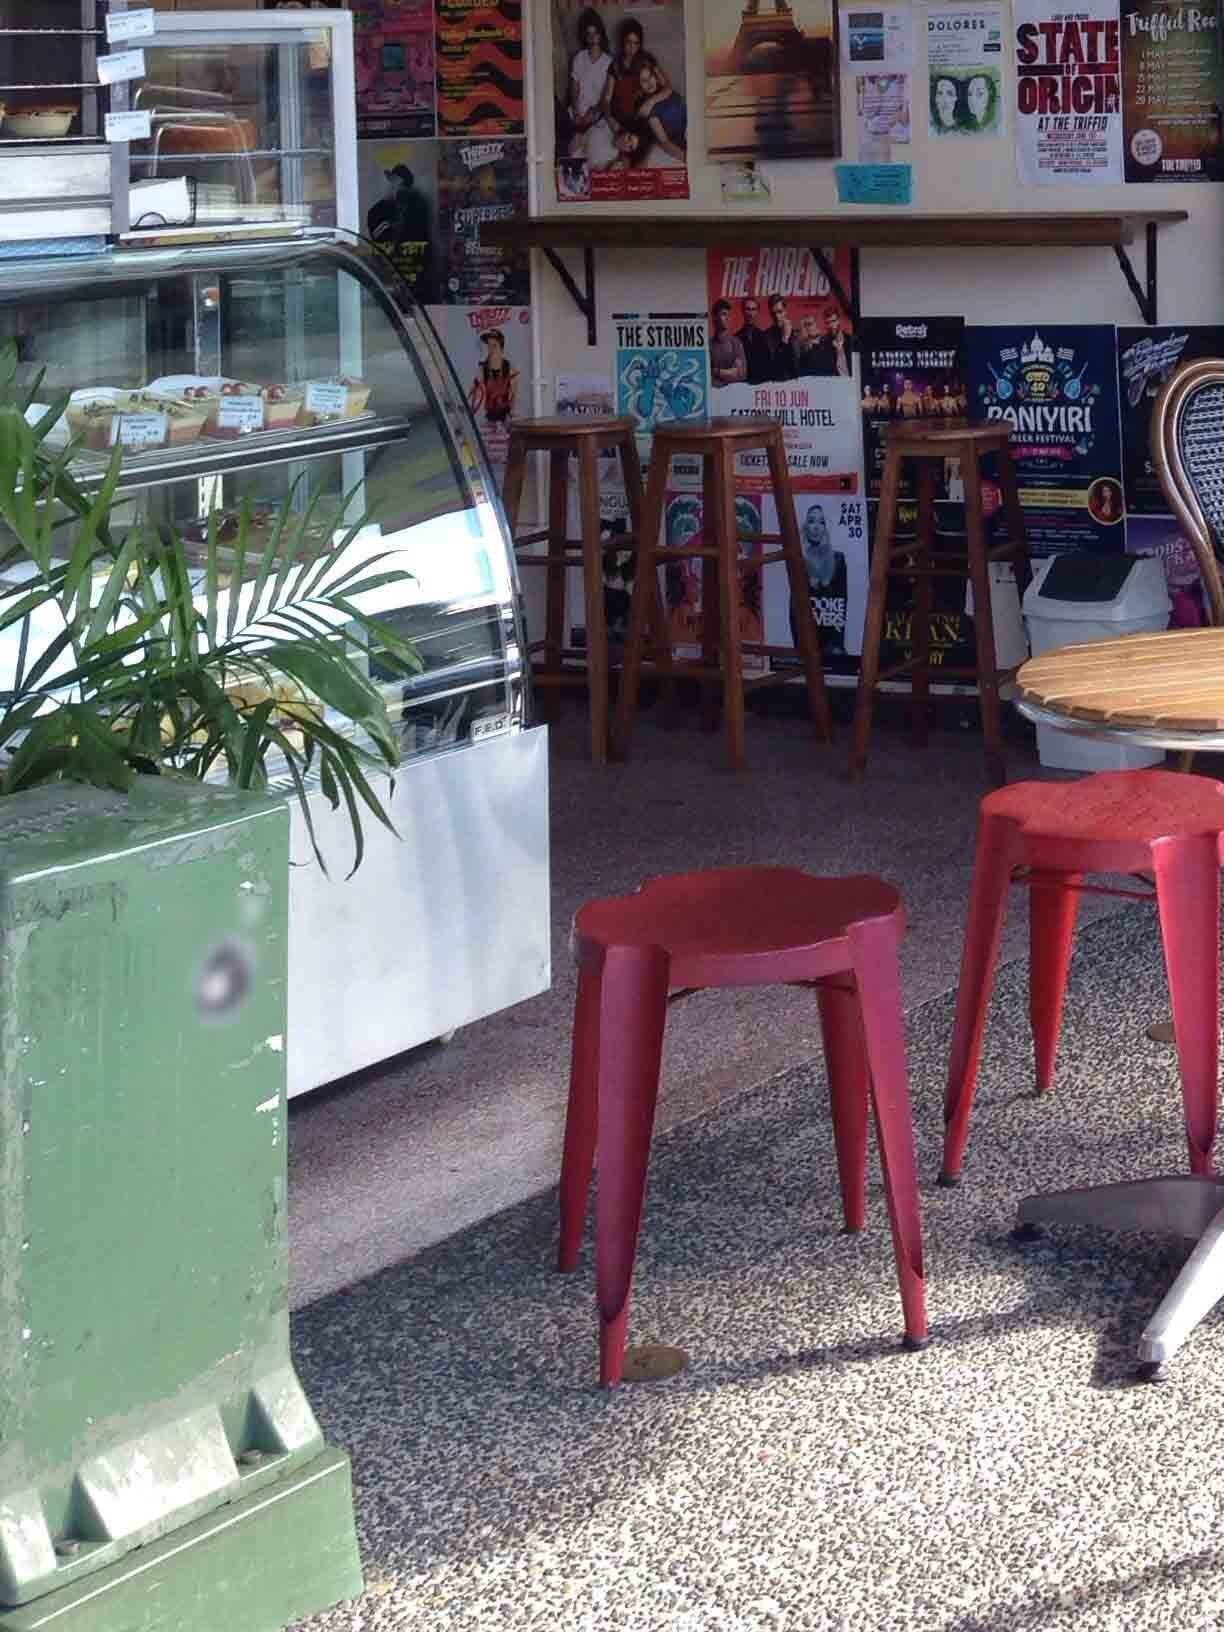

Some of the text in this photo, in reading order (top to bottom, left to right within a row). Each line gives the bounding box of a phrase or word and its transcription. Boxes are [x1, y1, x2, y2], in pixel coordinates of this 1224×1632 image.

[927, 20, 986, 31] DOLORES
[1016, 20, 1119, 65] STATE
[1037, 116, 1049, 130] AT
[1053, 116, 1069, 129] THE
[720, 257, 752, 297] THE
[617, 325, 705, 347] THE STRUMS
[871, 350, 957, 369] LADIES NIGHT
[754, 390, 774, 407] FRI
[789, 389, 809, 406] JUN
[800, 408, 836, 426] HOTEL
[1035, 434, 1076, 443] FESTIVAL
[740, 454, 770, 468] TICKET
[809, 455, 829, 468] NOW
[841, 503, 862, 514] SAT
[839, 515, 863, 526] APR
[848, 527, 863, 539] 30
[815, 613, 847, 627] VERS
